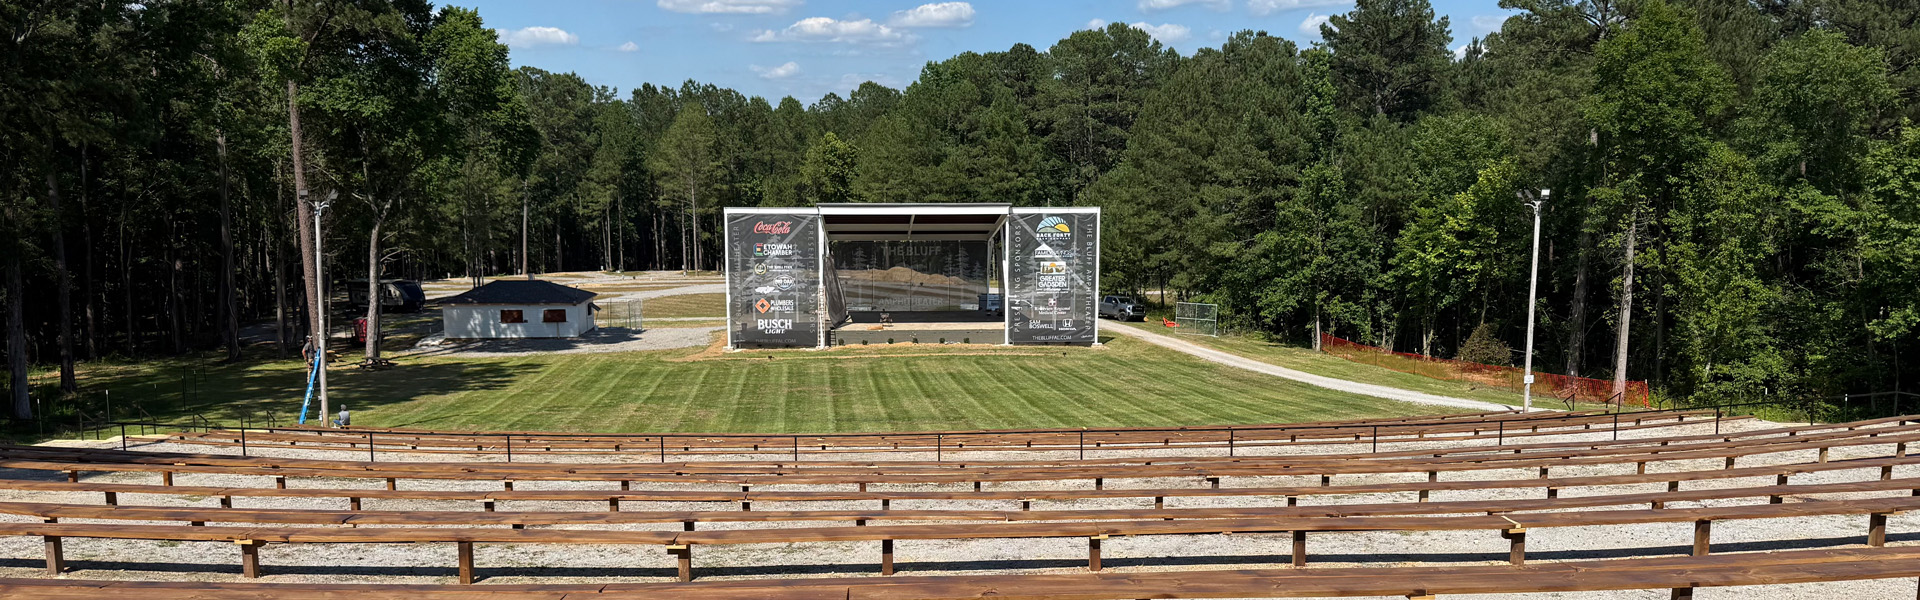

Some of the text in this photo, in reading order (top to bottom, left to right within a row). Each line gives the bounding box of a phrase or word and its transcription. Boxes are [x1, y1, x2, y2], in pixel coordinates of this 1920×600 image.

[754, 220, 792, 235] Coca-Cola
[881, 245, 941, 256] THE BLUFF
[878, 297, 943, 306] AMPHITHEATER
[757, 318, 793, 330] BUSCH
